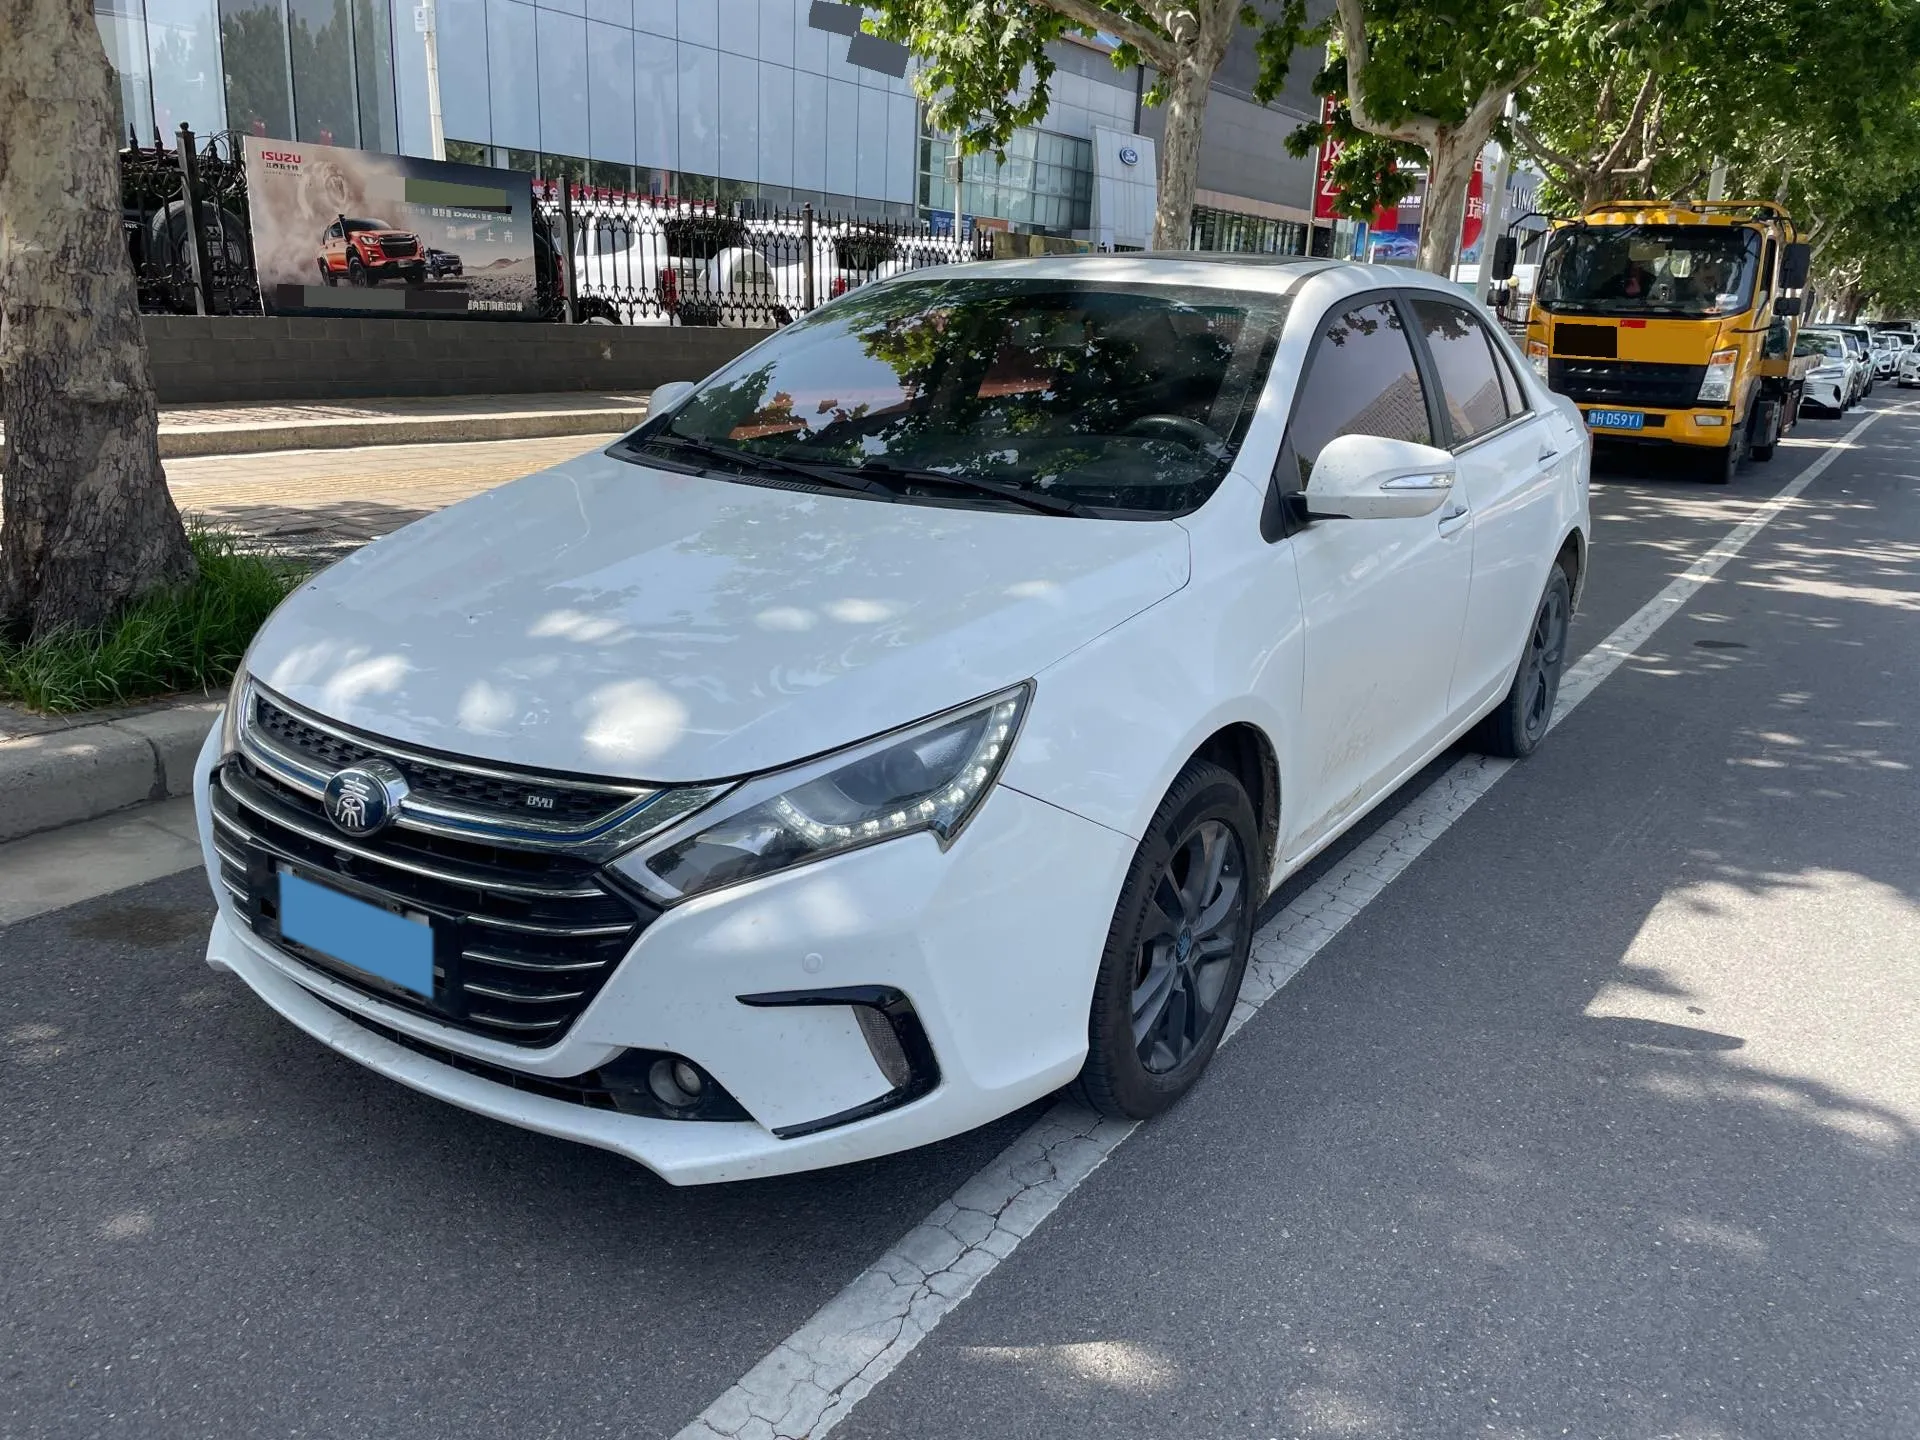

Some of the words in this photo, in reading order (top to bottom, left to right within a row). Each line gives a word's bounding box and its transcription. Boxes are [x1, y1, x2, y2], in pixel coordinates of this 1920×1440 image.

[262, 151, 301, 164] ISUZU
[335, 778, 370, 827] 秦
[528, 795, 554, 808] BYD
